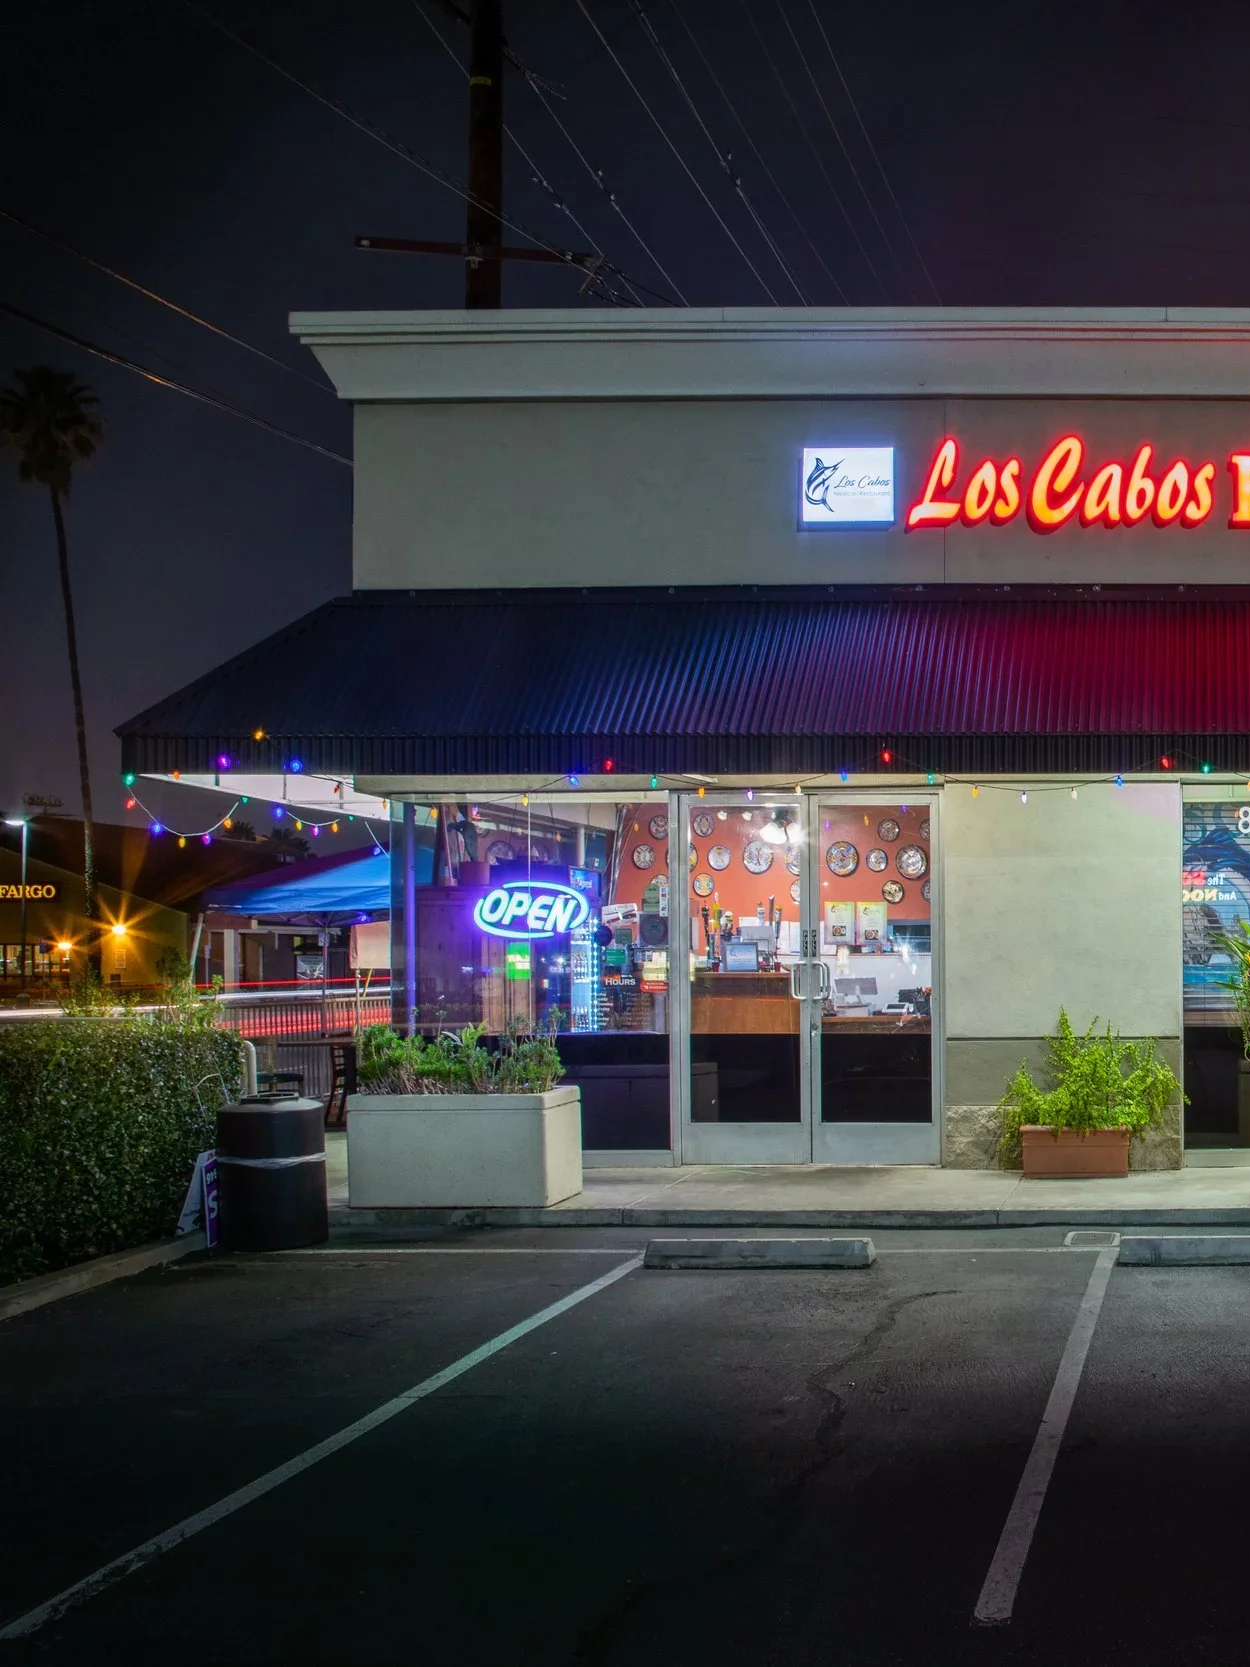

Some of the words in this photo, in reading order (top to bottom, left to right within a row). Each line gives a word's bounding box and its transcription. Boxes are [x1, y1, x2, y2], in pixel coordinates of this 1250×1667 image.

[833, 475, 856, 489] Los
[857, 475, 891, 489] Cabos
[906, 437, 1020, 529] Los
[1027, 435, 1216, 534] Cabos
[0, 885, 56, 899] FARGO
[481, 888, 578, 934] OPEN
